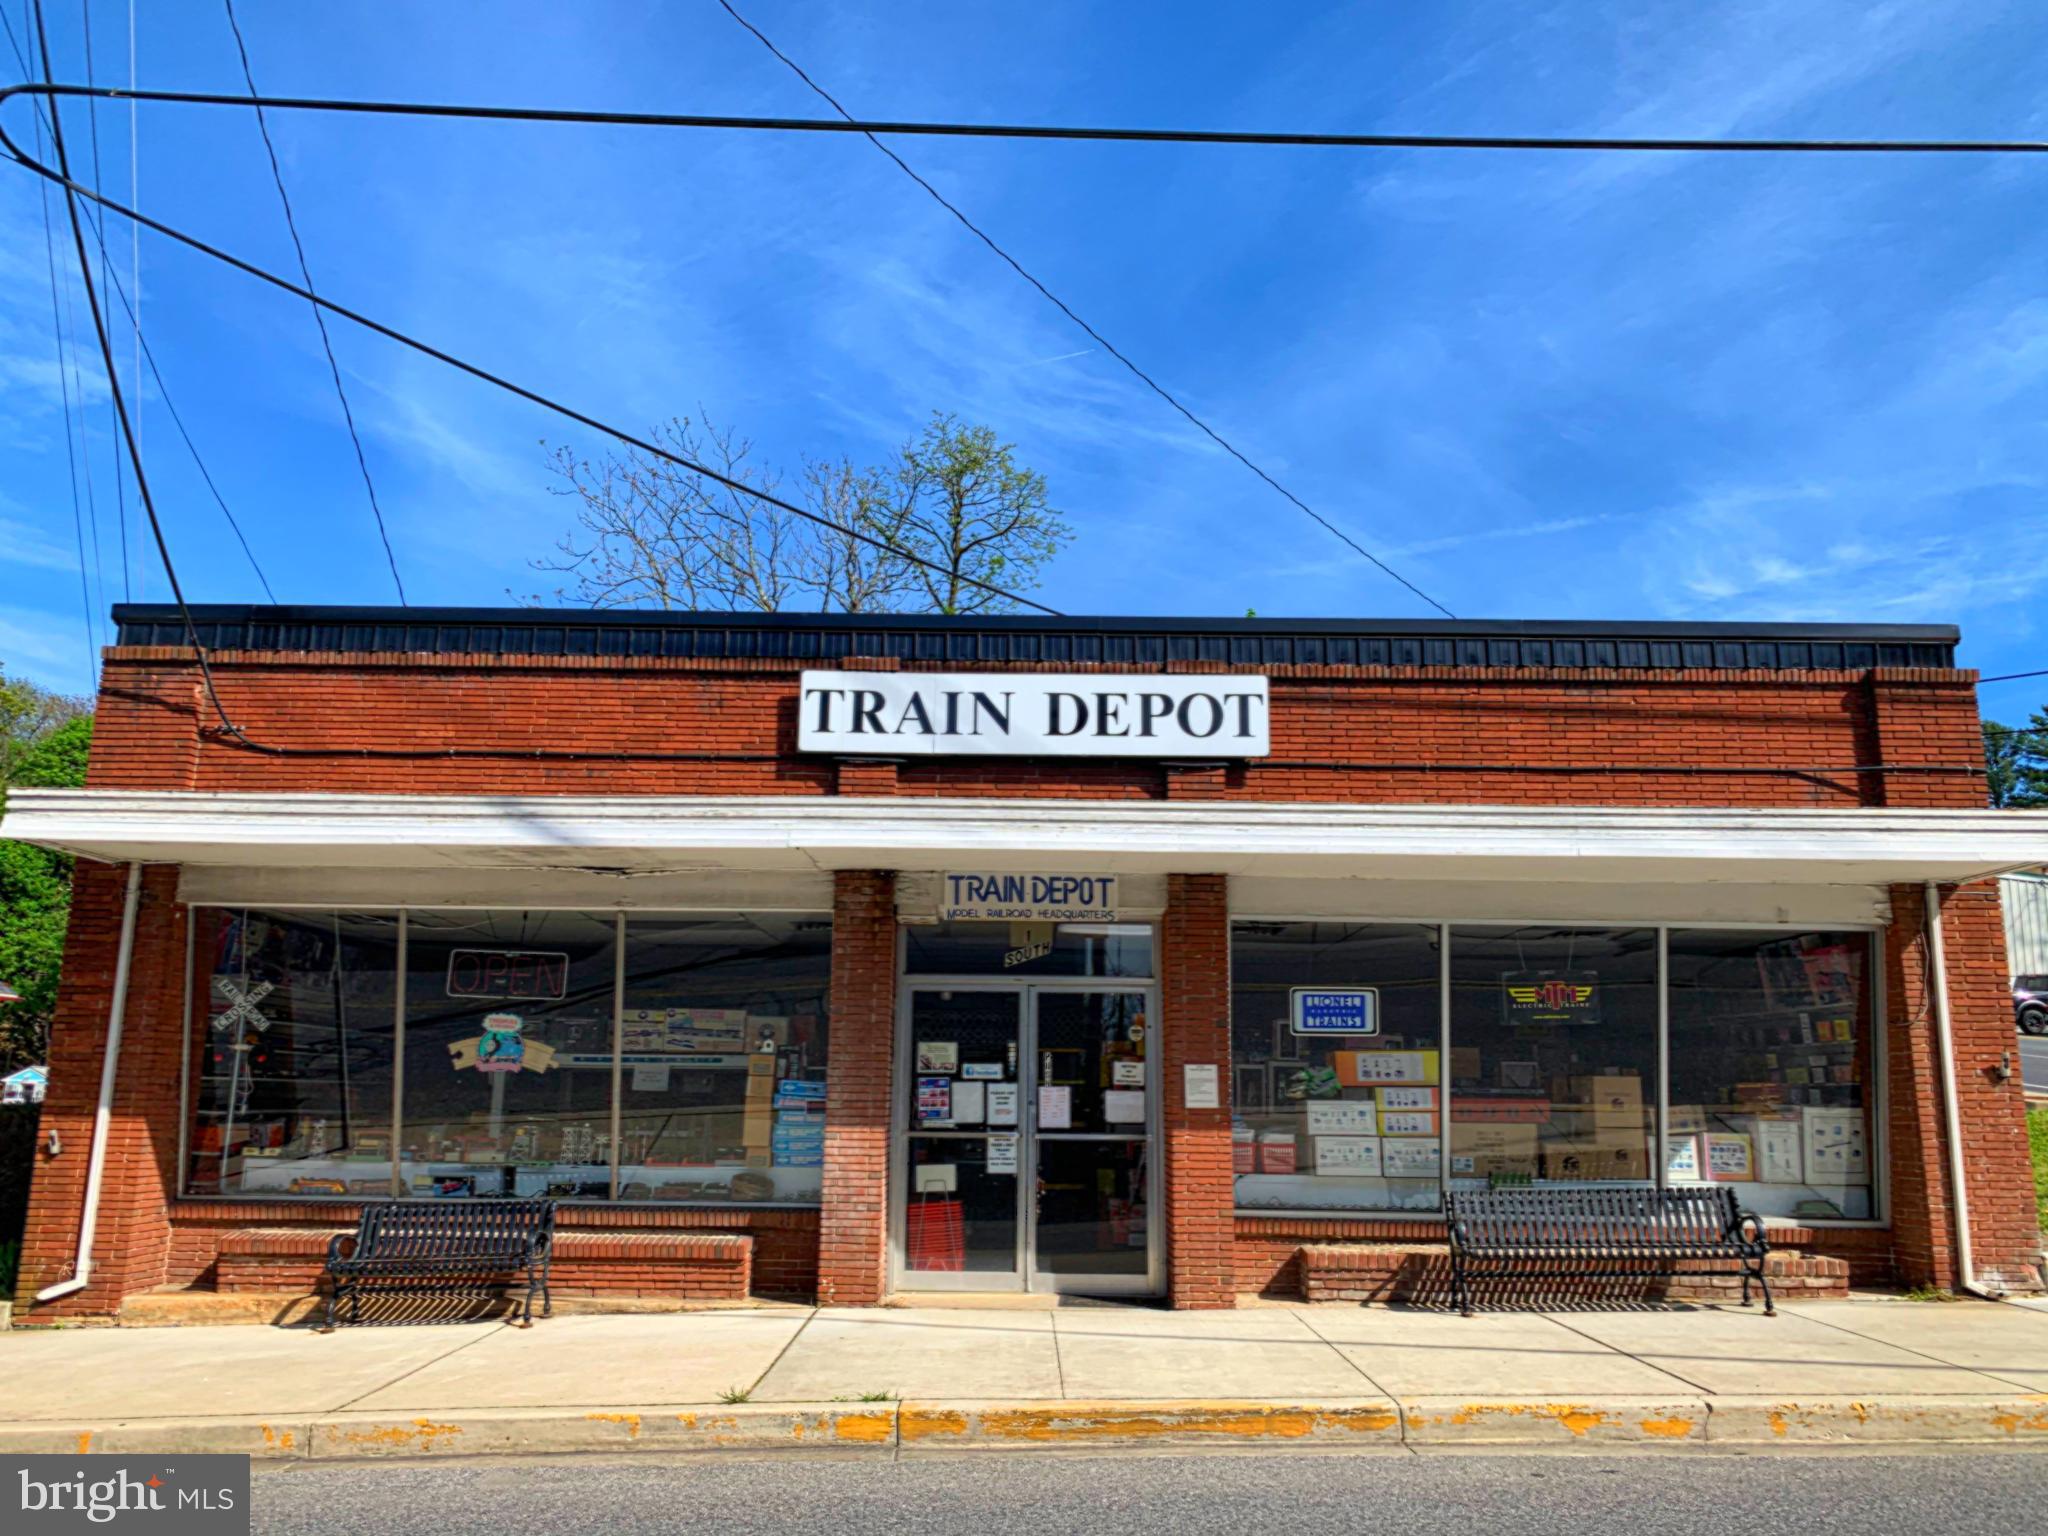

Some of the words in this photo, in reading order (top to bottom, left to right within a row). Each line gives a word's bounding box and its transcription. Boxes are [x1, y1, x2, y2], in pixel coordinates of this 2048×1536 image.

[805, 689, 1016, 736] TRAIN
[1043, 692, 1263, 738] DEPOT
[947, 875, 1025, 905] TRAIN
[1031, 876, 1115, 908] DEPOT
[947, 908, 980, 920] MODEL
[987, 908, 1032, 919] RAILROAD
[1038, 908, 1115, 922] HEADQUARTERS
[1005, 942, 1050, 966] SOUTH
[453, 954, 565, 996] OPEN
[217, 982, 271, 1029] CROSSING
[1309, 995, 1359, 1008] LIONEL
[1309, 1016, 1360, 1028] TRAINS
